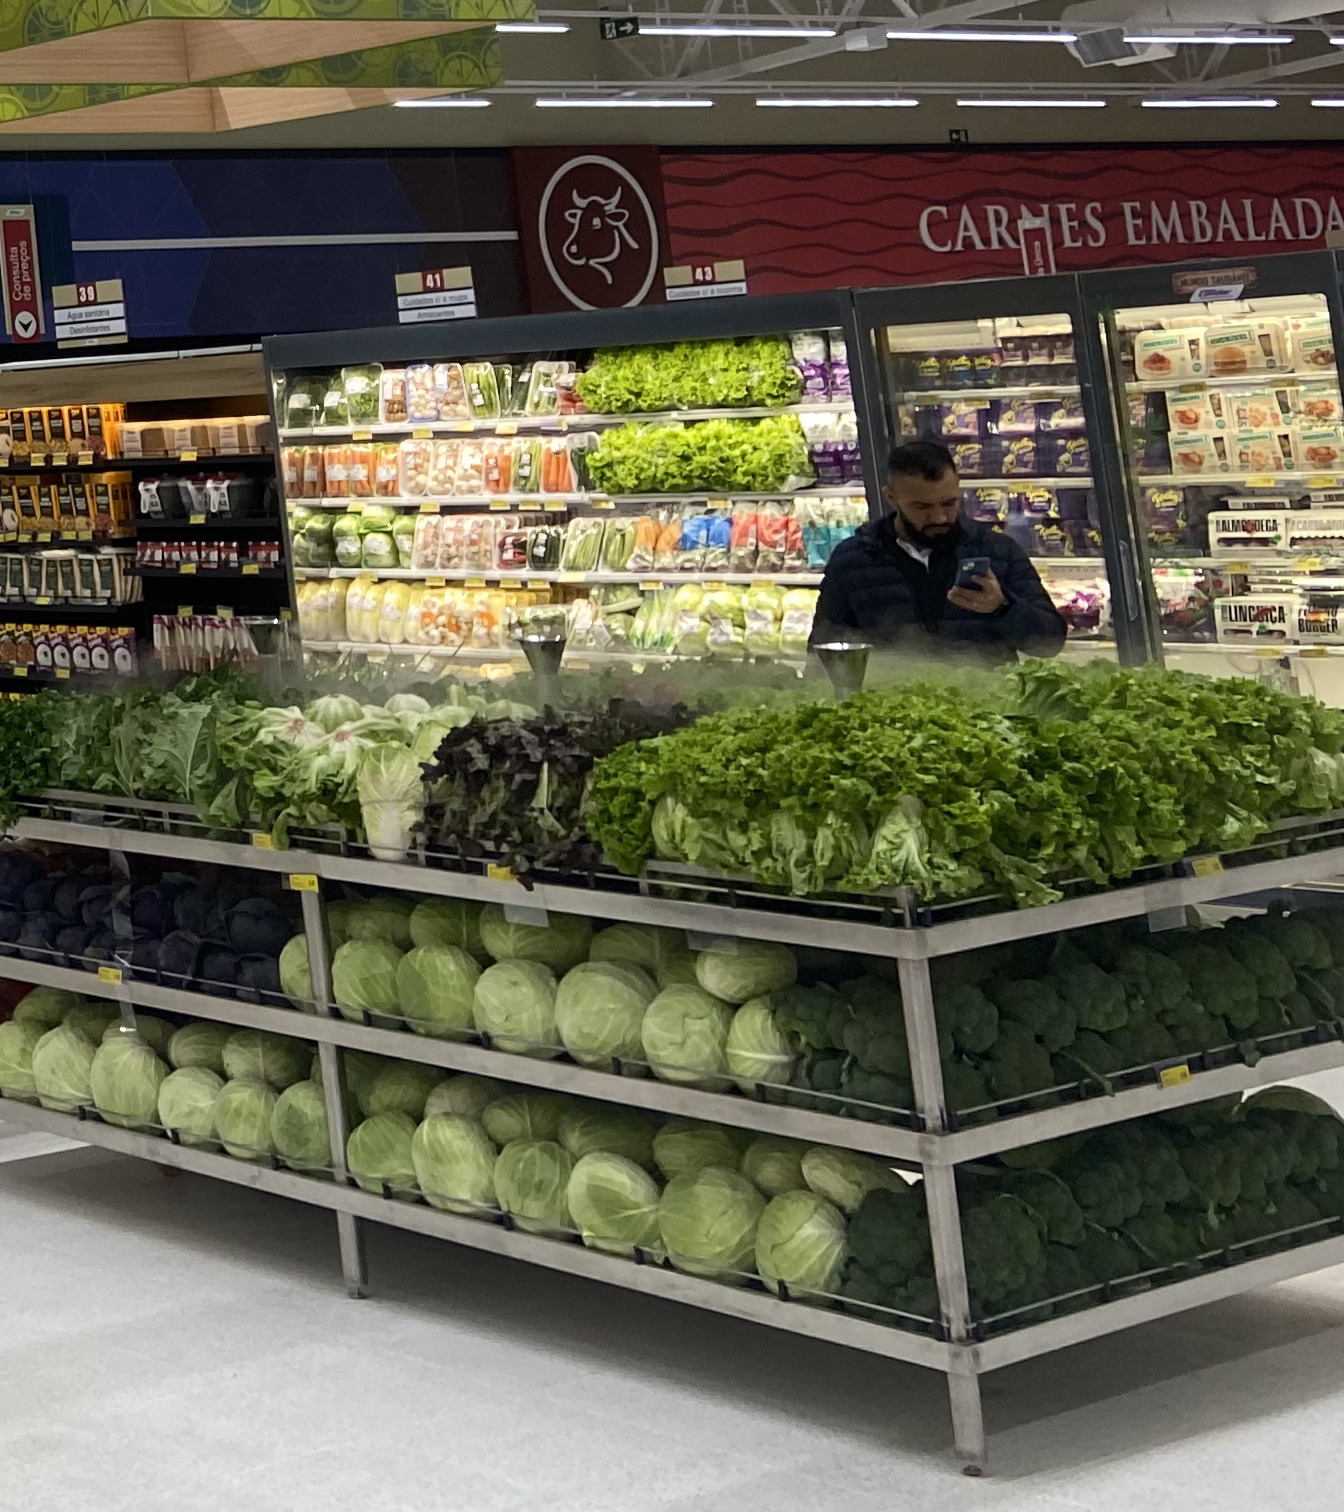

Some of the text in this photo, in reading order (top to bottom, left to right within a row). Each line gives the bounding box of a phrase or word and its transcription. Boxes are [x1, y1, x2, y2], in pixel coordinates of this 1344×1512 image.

[10, 246, 23, 301] Consulta
[18, 240, 33, 301] de preços
[695, 266, 713, 281] 43
[425, 273, 441, 289] 41
[78, 285, 95, 302] 39
